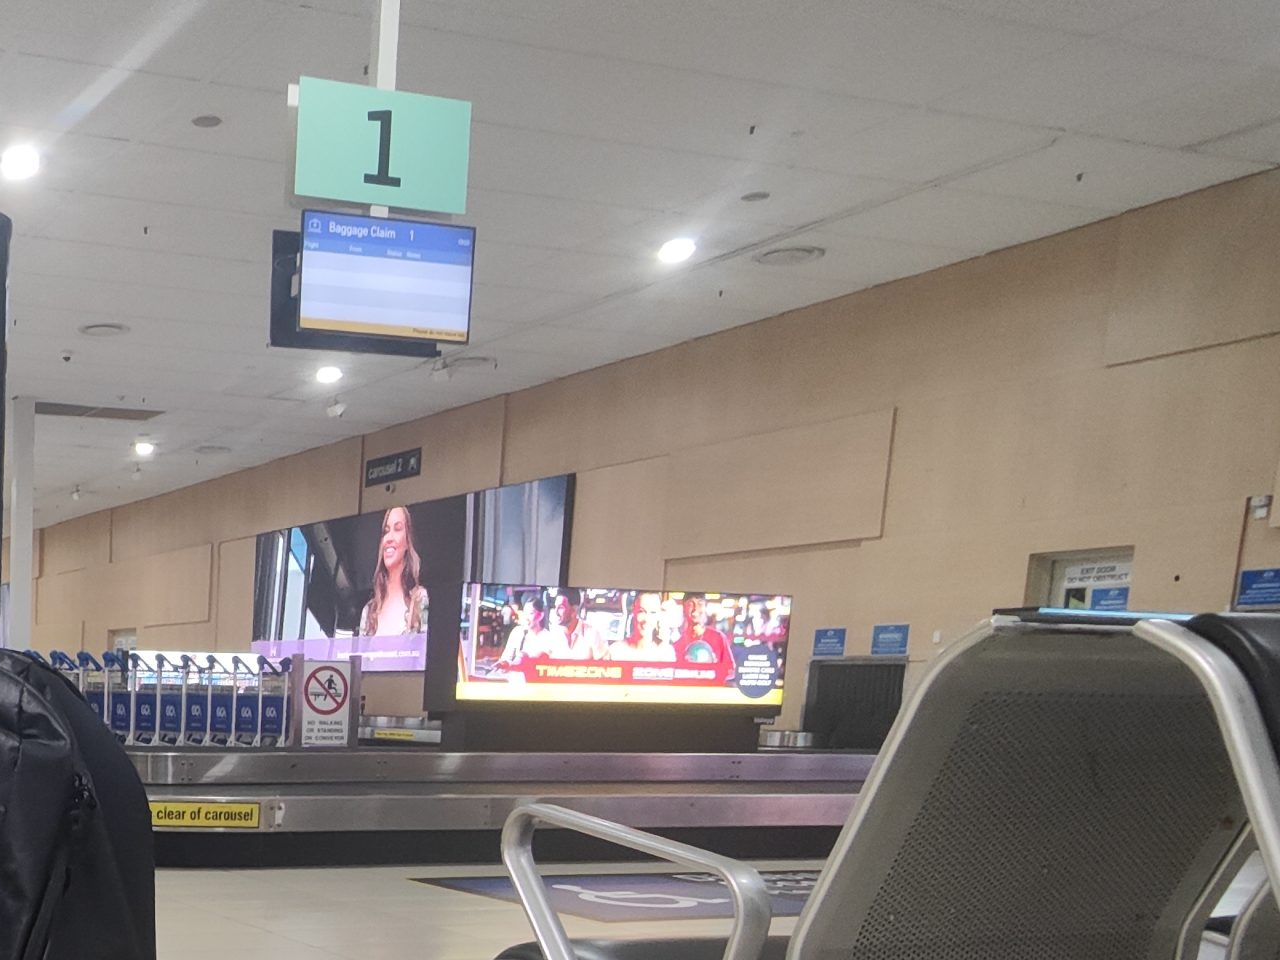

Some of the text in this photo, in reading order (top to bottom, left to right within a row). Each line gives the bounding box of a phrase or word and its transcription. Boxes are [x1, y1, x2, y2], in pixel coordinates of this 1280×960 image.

[363, 109, 402, 188] 1
[328, 221, 415, 241] Baggage Claim 1
[156, 806, 254, 821] clear of carousel
